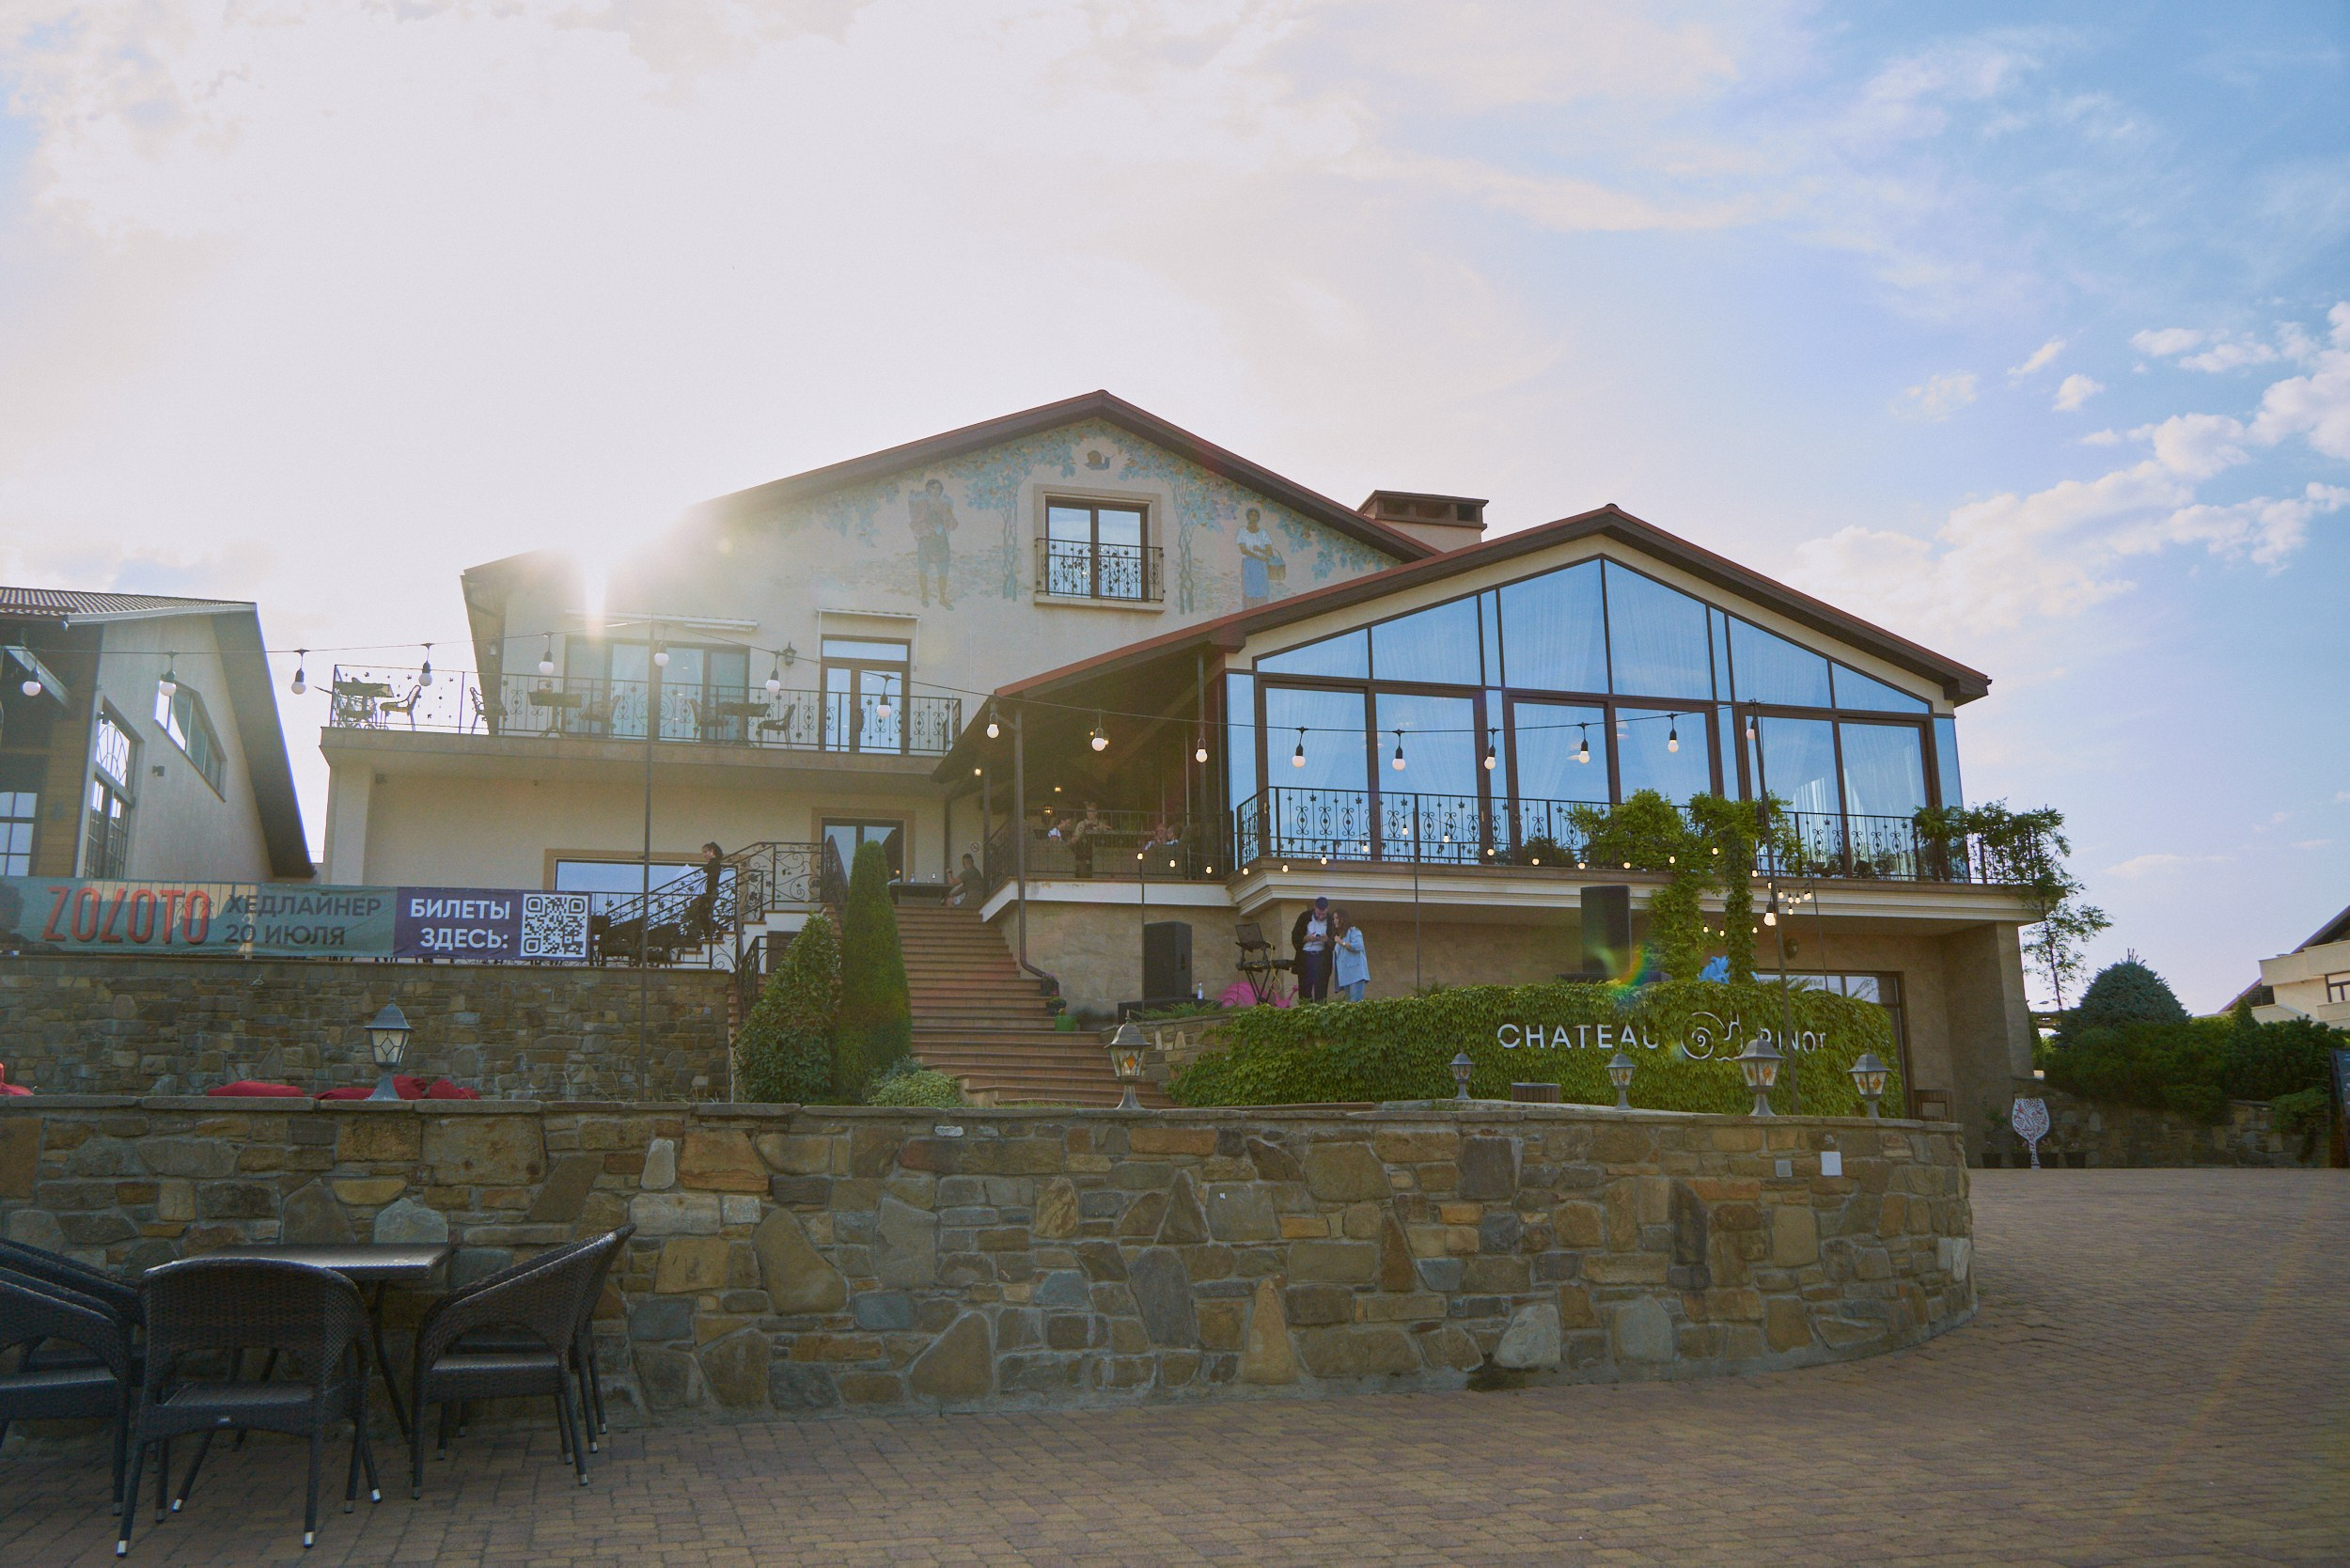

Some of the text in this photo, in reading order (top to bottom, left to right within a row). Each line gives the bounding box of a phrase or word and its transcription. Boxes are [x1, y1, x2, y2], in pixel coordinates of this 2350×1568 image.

[227, 893, 382, 917] ХЕДЛАЙНЕР
[410, 898, 510, 920] БИЛЕТЫ
[224, 924, 346, 946] 20 ИЮЛЯ
[420, 927, 509, 951] ЗДЕСЬ:
[1496, 1023, 1659, 1050] CHATEAU
